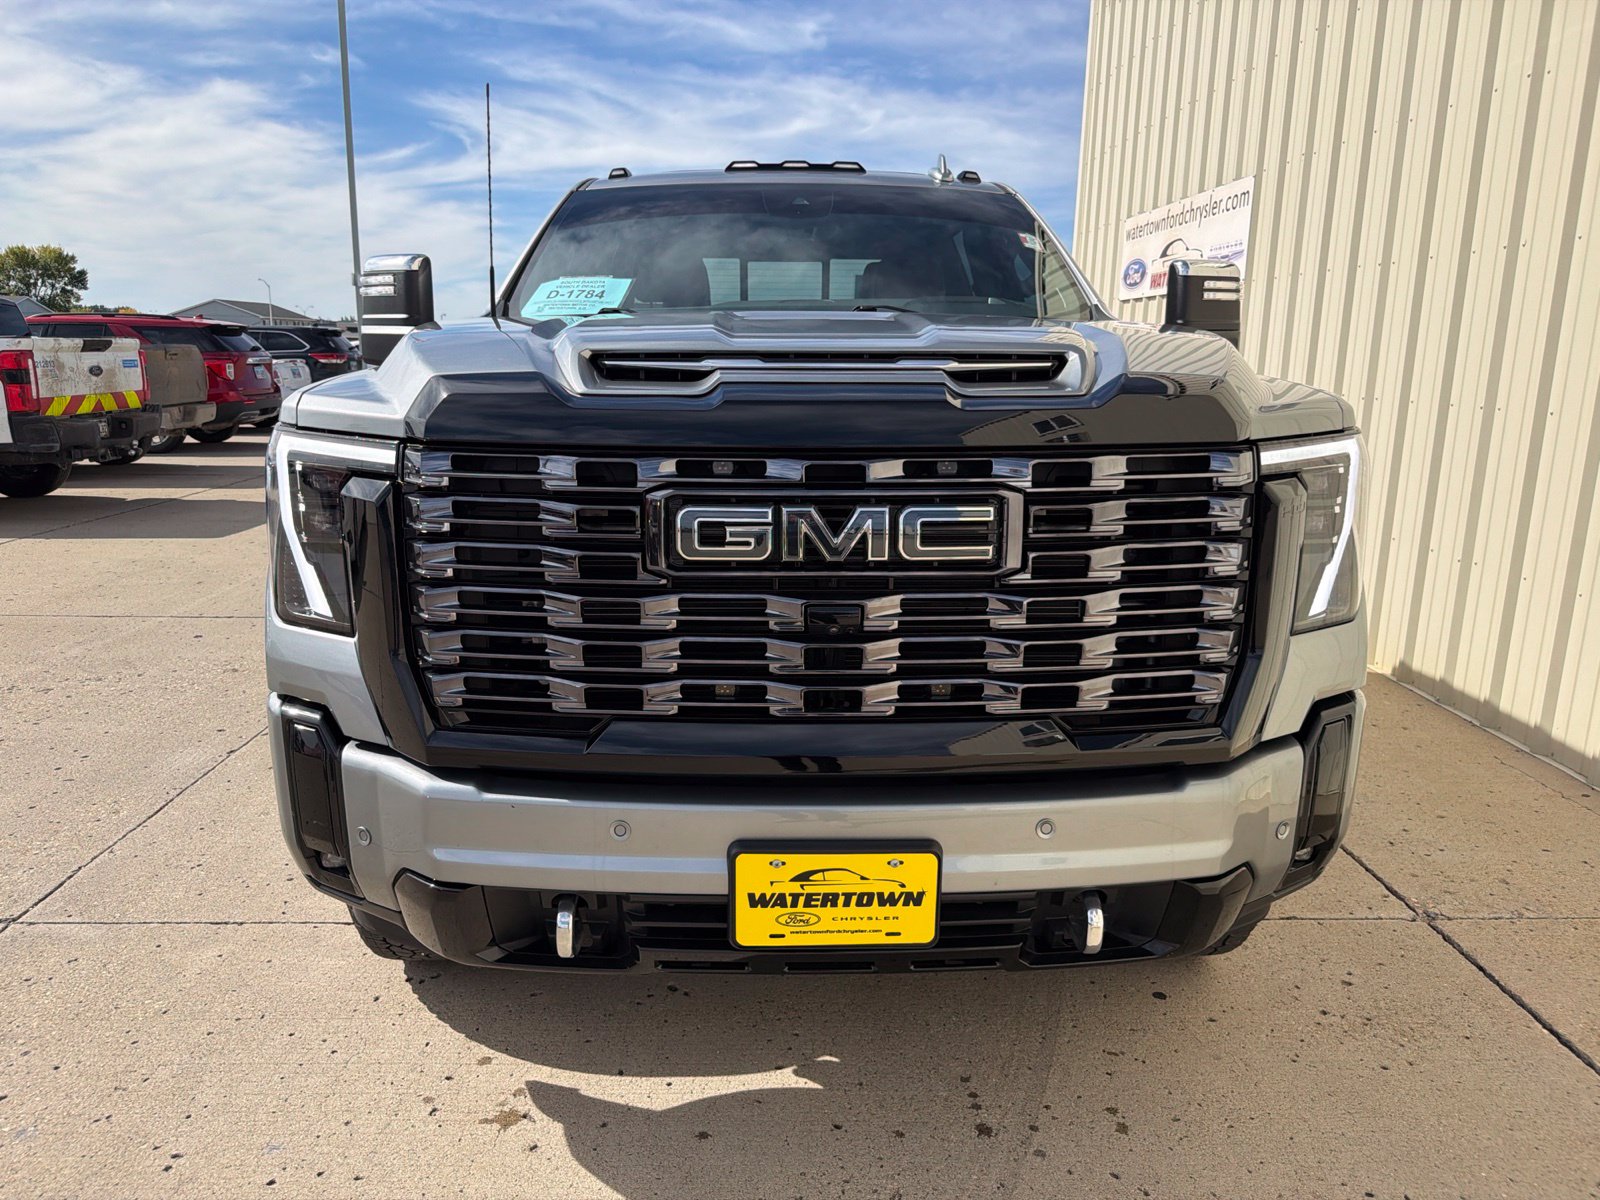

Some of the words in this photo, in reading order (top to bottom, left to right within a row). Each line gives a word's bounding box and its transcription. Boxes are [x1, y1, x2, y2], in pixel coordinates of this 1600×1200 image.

[1125, 190, 1250, 242] watertownfordchrysler.com
[1126, 264, 1143, 285] Ford
[546, 289, 606, 300] D-1784
[675, 504, 996, 562] GMC
[747, 891, 926, 908] WATERTOWN
[784, 914, 811, 925] Ford
